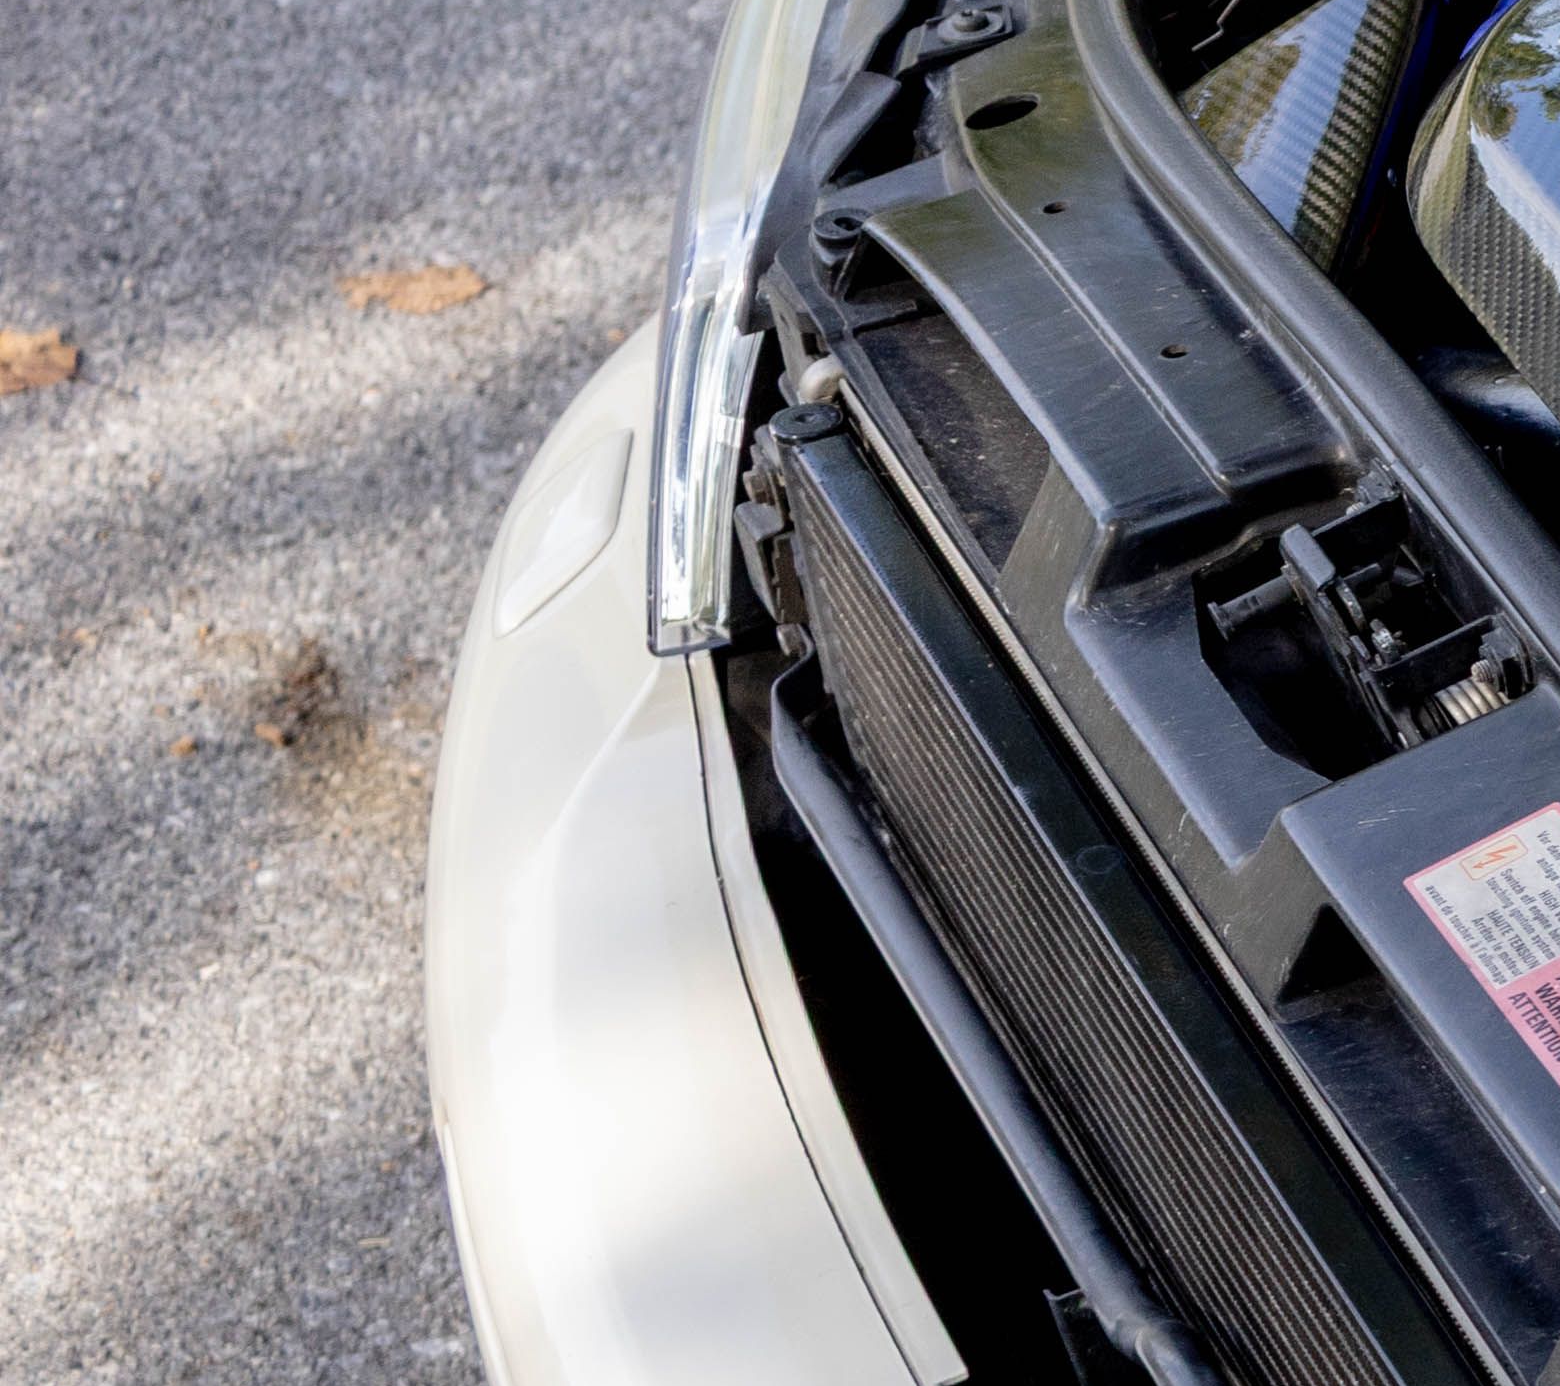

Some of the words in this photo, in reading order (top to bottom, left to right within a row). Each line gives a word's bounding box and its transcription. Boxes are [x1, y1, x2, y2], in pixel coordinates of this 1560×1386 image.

[1482, 876, 1516, 909] touching
[1506, 906, 1538, 935] ignition
[1529, 933, 1558, 961] system
[1499, 867, 1528, 895] Switch
[1525, 903, 1555, 931] engine
[1536, 889, 1560, 911] HIGH
[1485, 909, 1514, 936] HAUTE
[1505, 934, 1542, 969] TENSION
[1496, 950, 1525, 977] moteur
